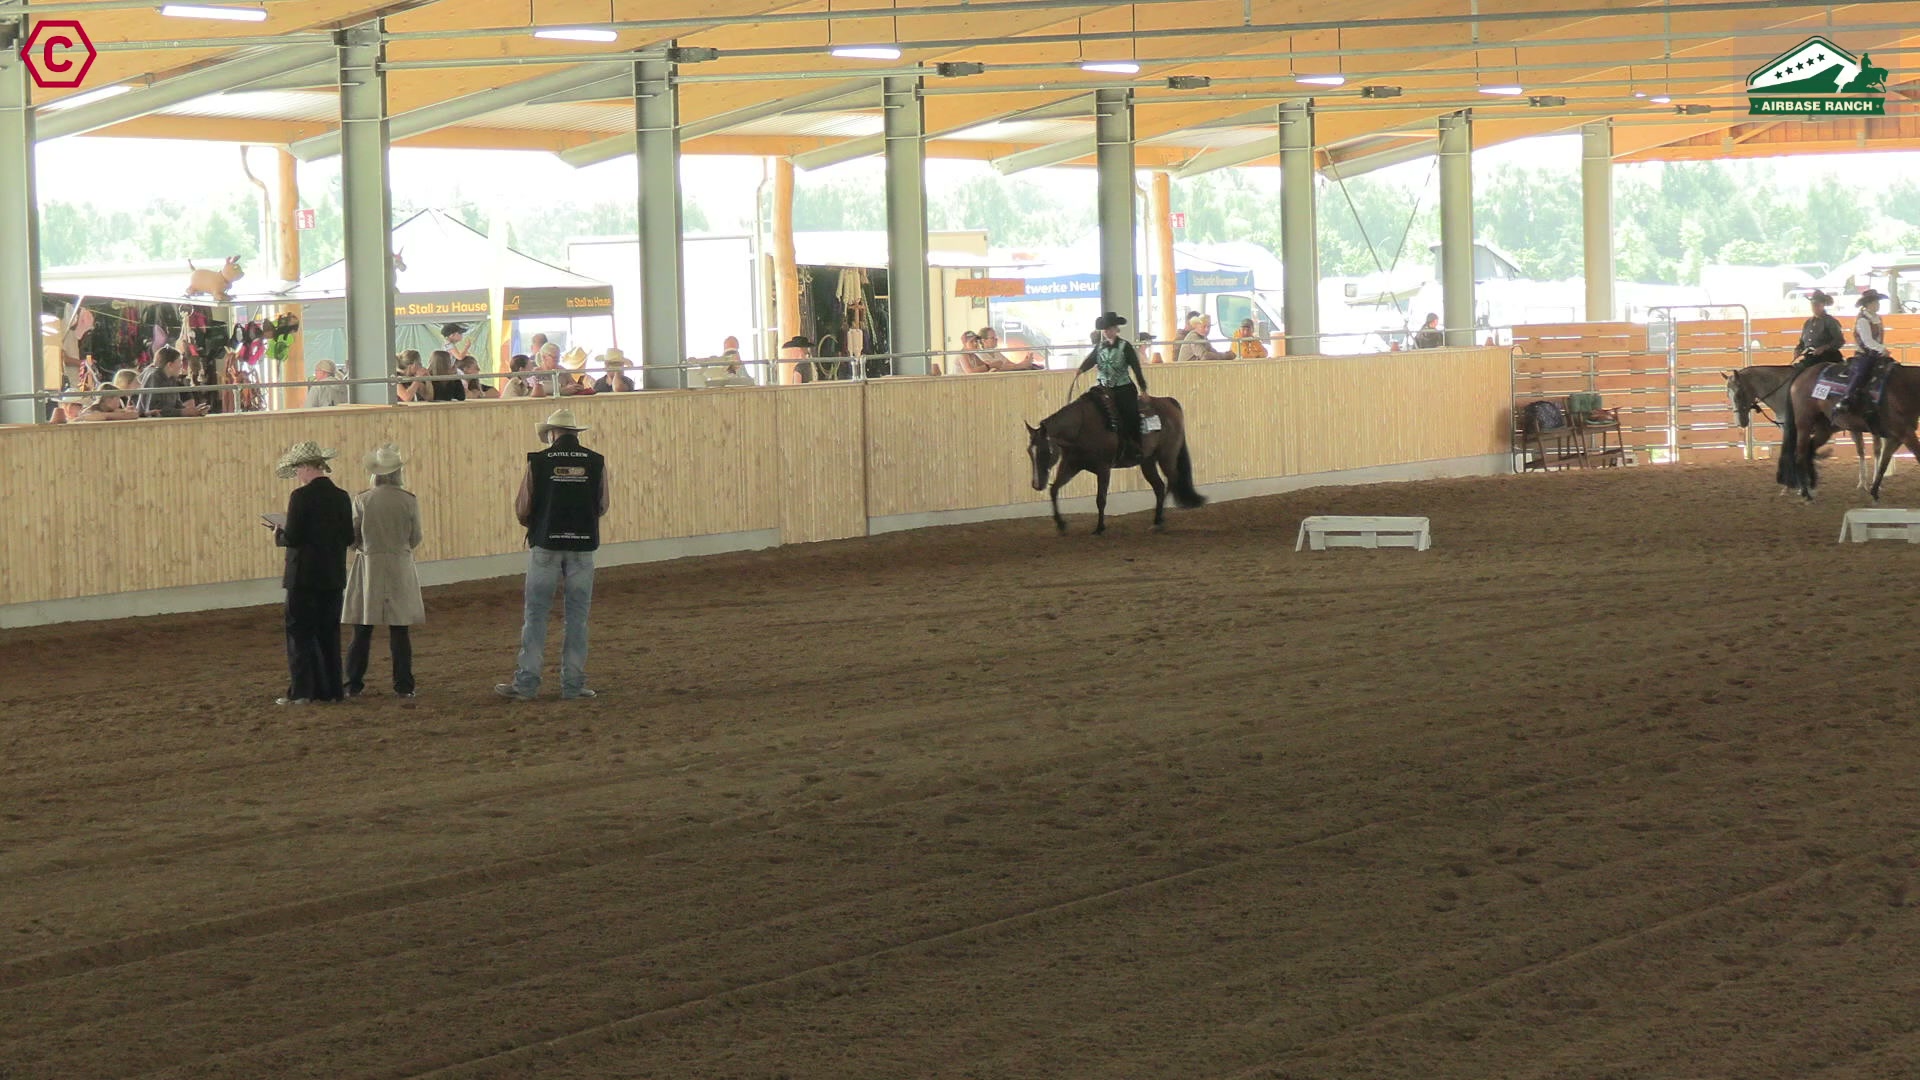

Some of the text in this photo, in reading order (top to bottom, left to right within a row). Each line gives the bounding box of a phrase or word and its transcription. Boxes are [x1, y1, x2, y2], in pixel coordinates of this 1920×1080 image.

[1025, 282, 1068, 295] twerke
[1070, 280, 1100, 292] Neur
[394, 301, 488, 316] m Stall zu Hause
